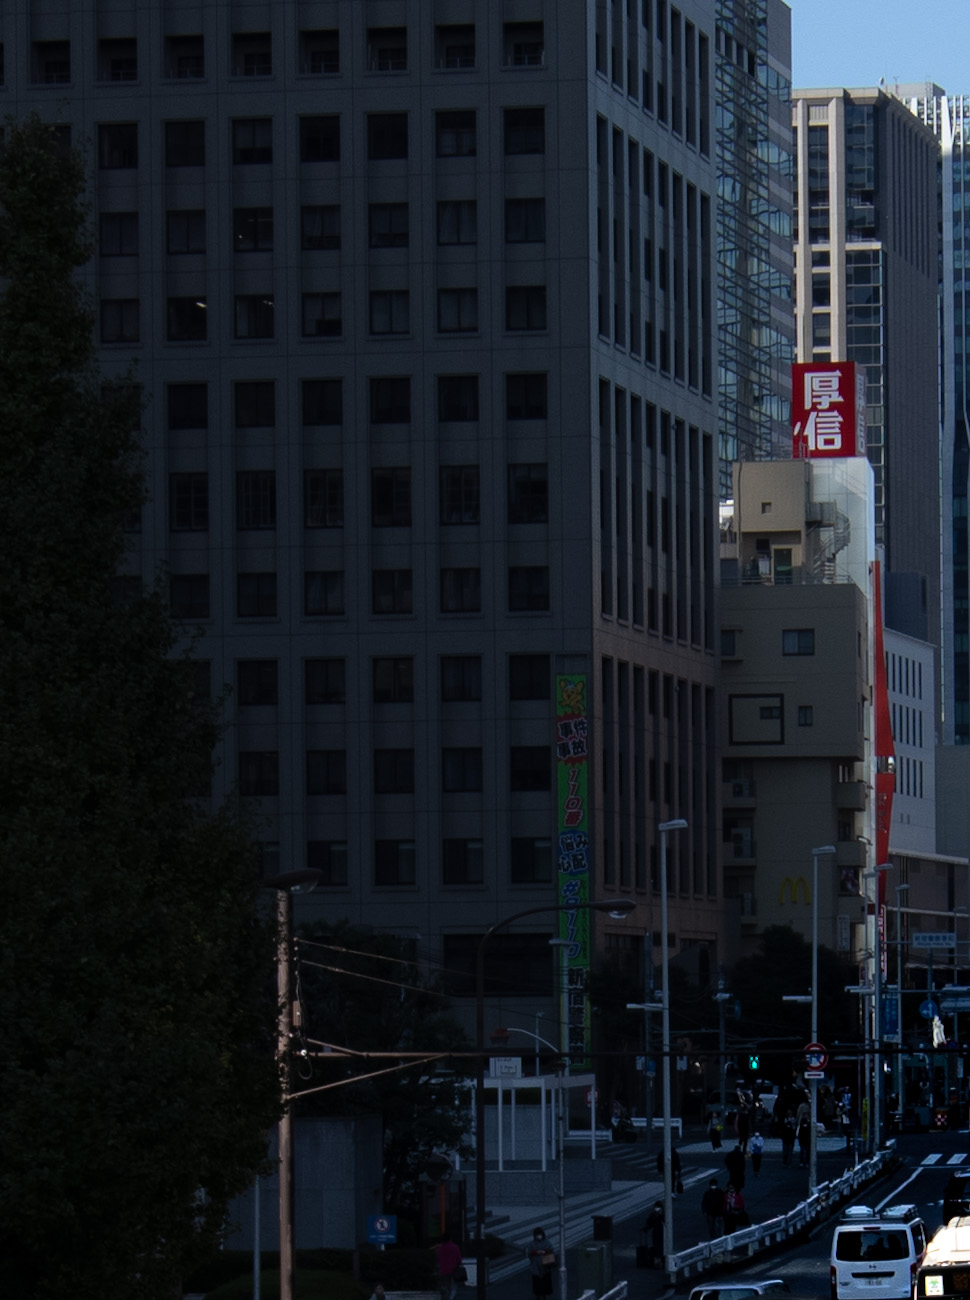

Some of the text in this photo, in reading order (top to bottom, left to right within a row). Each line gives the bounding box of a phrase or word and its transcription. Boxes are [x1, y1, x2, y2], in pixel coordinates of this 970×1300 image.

[793, 368, 845, 452] 厚信
[558, 718, 588, 739] 事件
[556, 739, 587, 760] 事故
